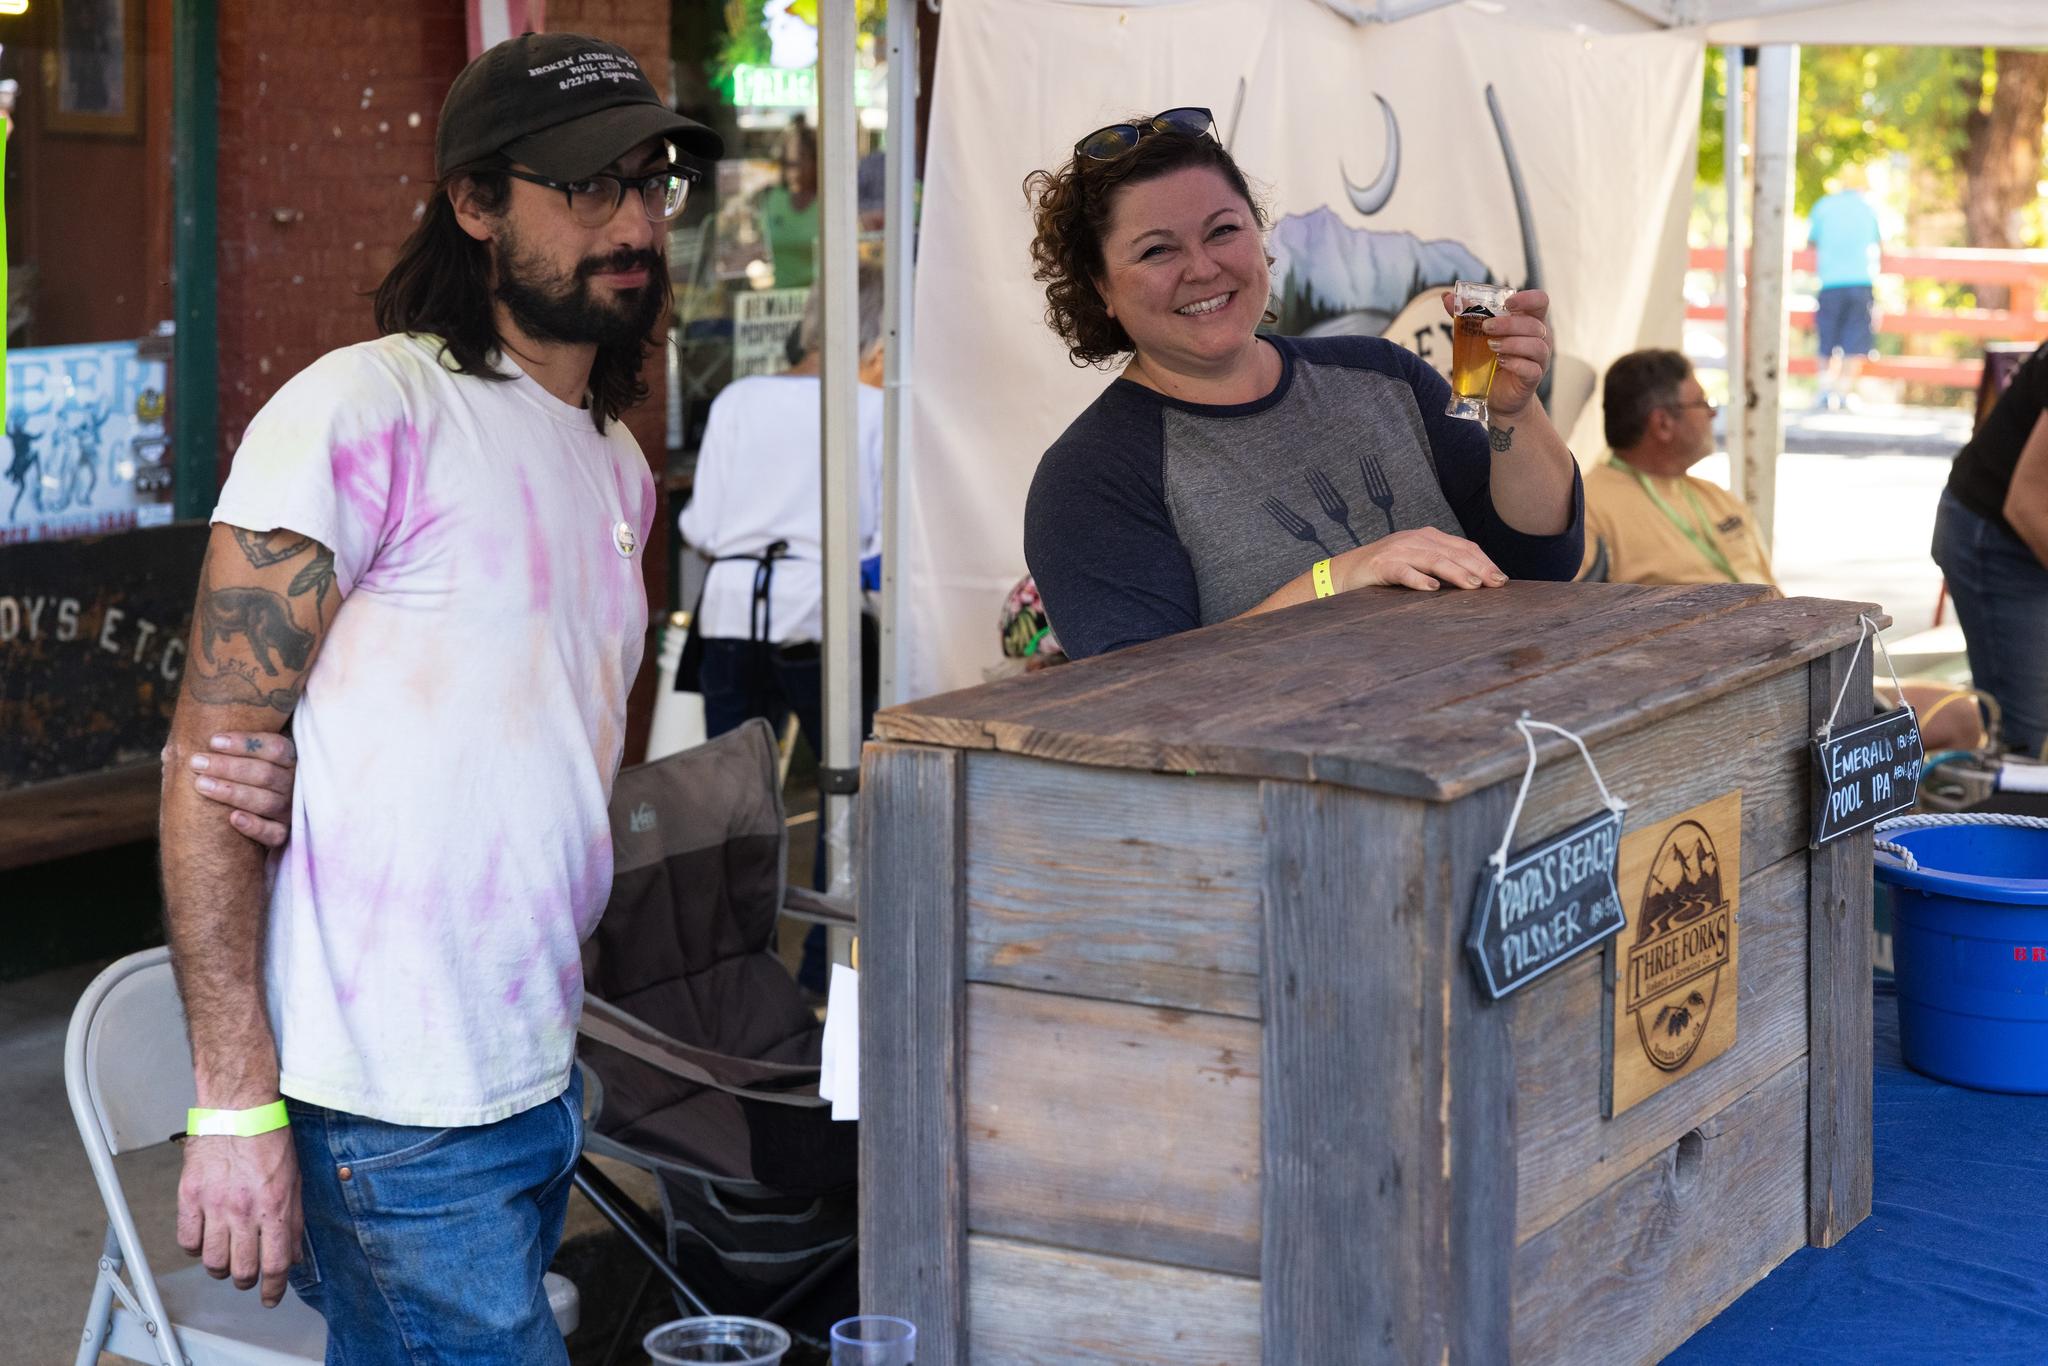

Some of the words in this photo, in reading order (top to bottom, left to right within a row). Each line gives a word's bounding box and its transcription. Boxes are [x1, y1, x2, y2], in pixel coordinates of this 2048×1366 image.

[528, 56, 574, 77] BROKEN
[569, 63, 598, 75] PHIL
[1832, 737, 1893, 782] EMERALD
[1832, 781, 1863, 823] POOL
[1872, 772, 1890, 803] IPA
[1499, 854, 1556, 931] PAPA'S
[1559, 826, 1614, 892] BEACH
[1502, 901, 1582, 978] PILSNER
[1631, 936, 1680, 999] THREE
[1683, 914, 1726, 961] FORKS
